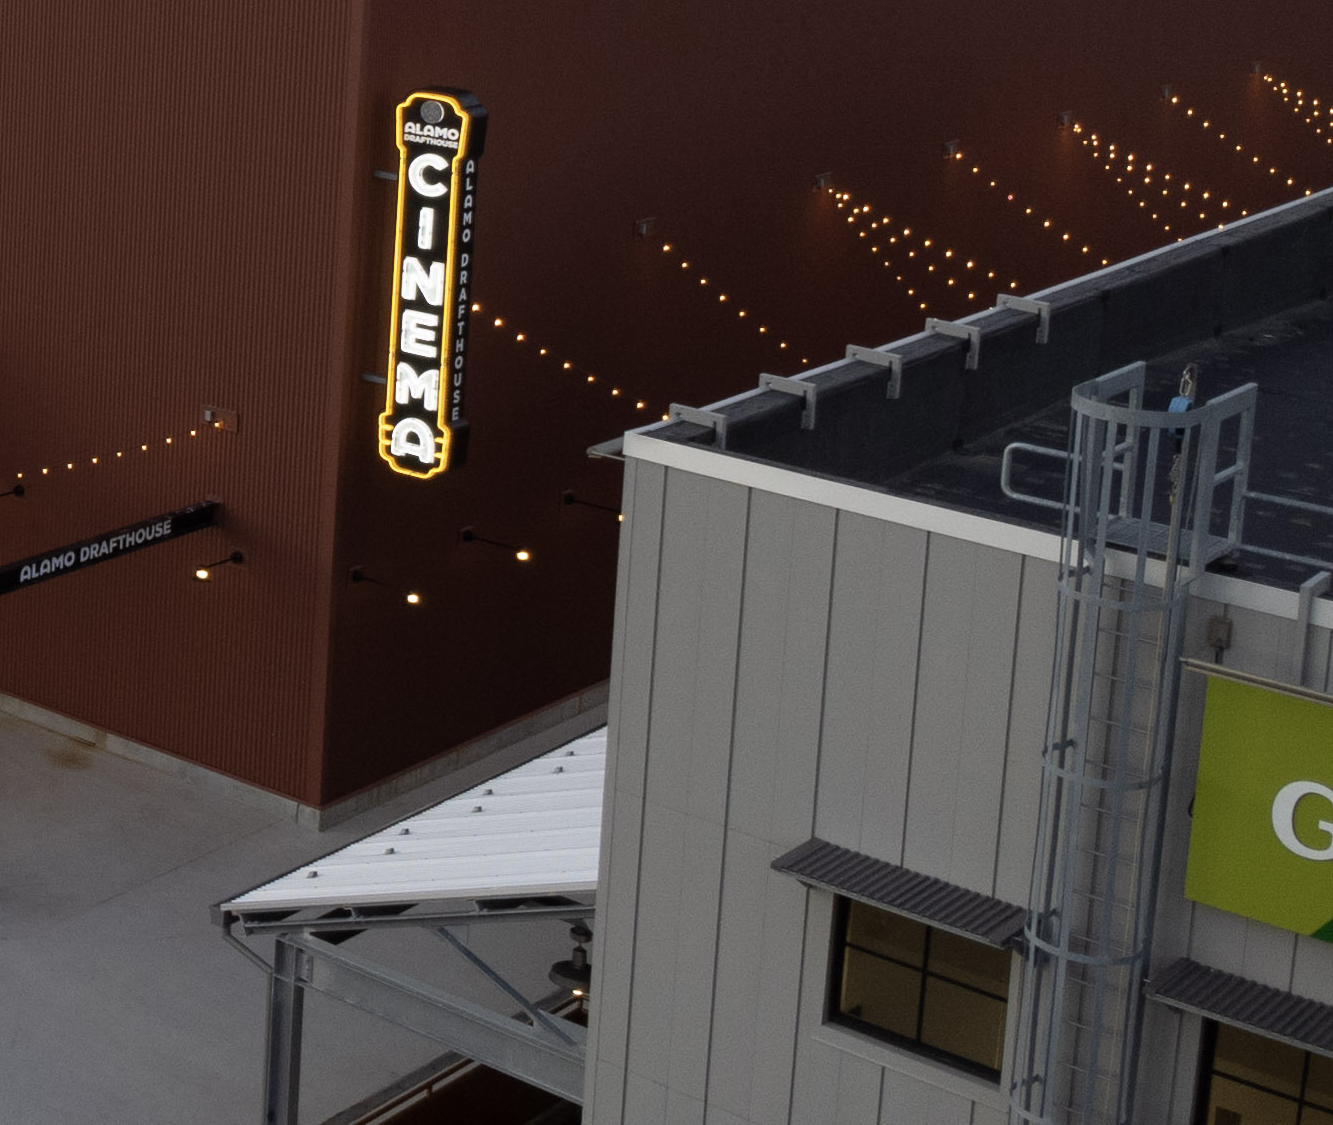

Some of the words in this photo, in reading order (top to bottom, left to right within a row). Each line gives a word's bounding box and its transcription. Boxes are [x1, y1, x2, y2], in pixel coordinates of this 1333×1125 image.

[403, 133, 459, 149] DRAFTHOUSE
[404, 121, 459, 141] ALAMO
[461, 159, 475, 244] ALAMO
[391, 153, 449, 464] CINEMA
[451, 253, 470, 422] DRAFTHOUSE
[19, 550, 76, 583] ALAMO
[80, 519, 172, 563] DRAFTHOUSE
